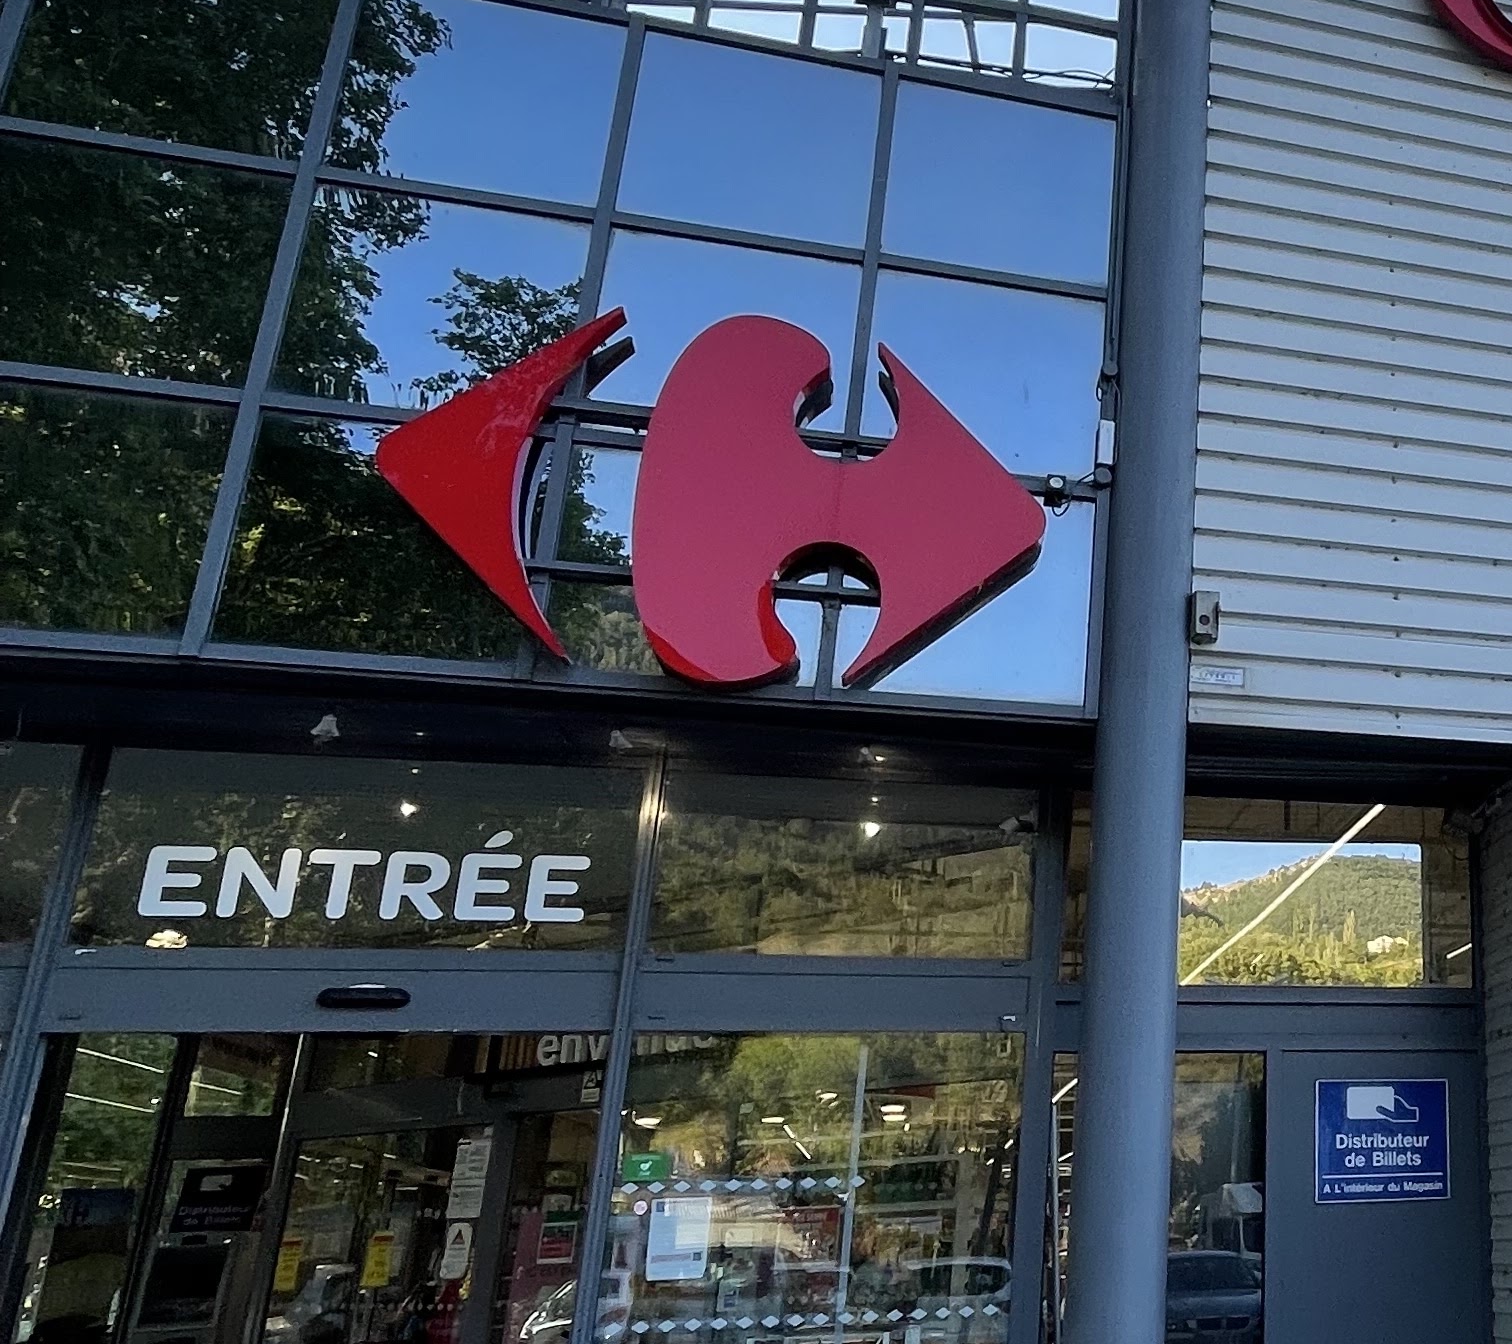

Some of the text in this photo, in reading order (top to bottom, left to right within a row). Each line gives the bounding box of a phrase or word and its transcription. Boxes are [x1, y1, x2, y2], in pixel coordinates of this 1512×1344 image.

[137, 830, 592, 923] ENTRÉE
[1335, 1133, 1430, 1149] Distributeur
[1344, 1151, 1422, 1168] de Billets
[1387, 1182, 1400, 1192] du
